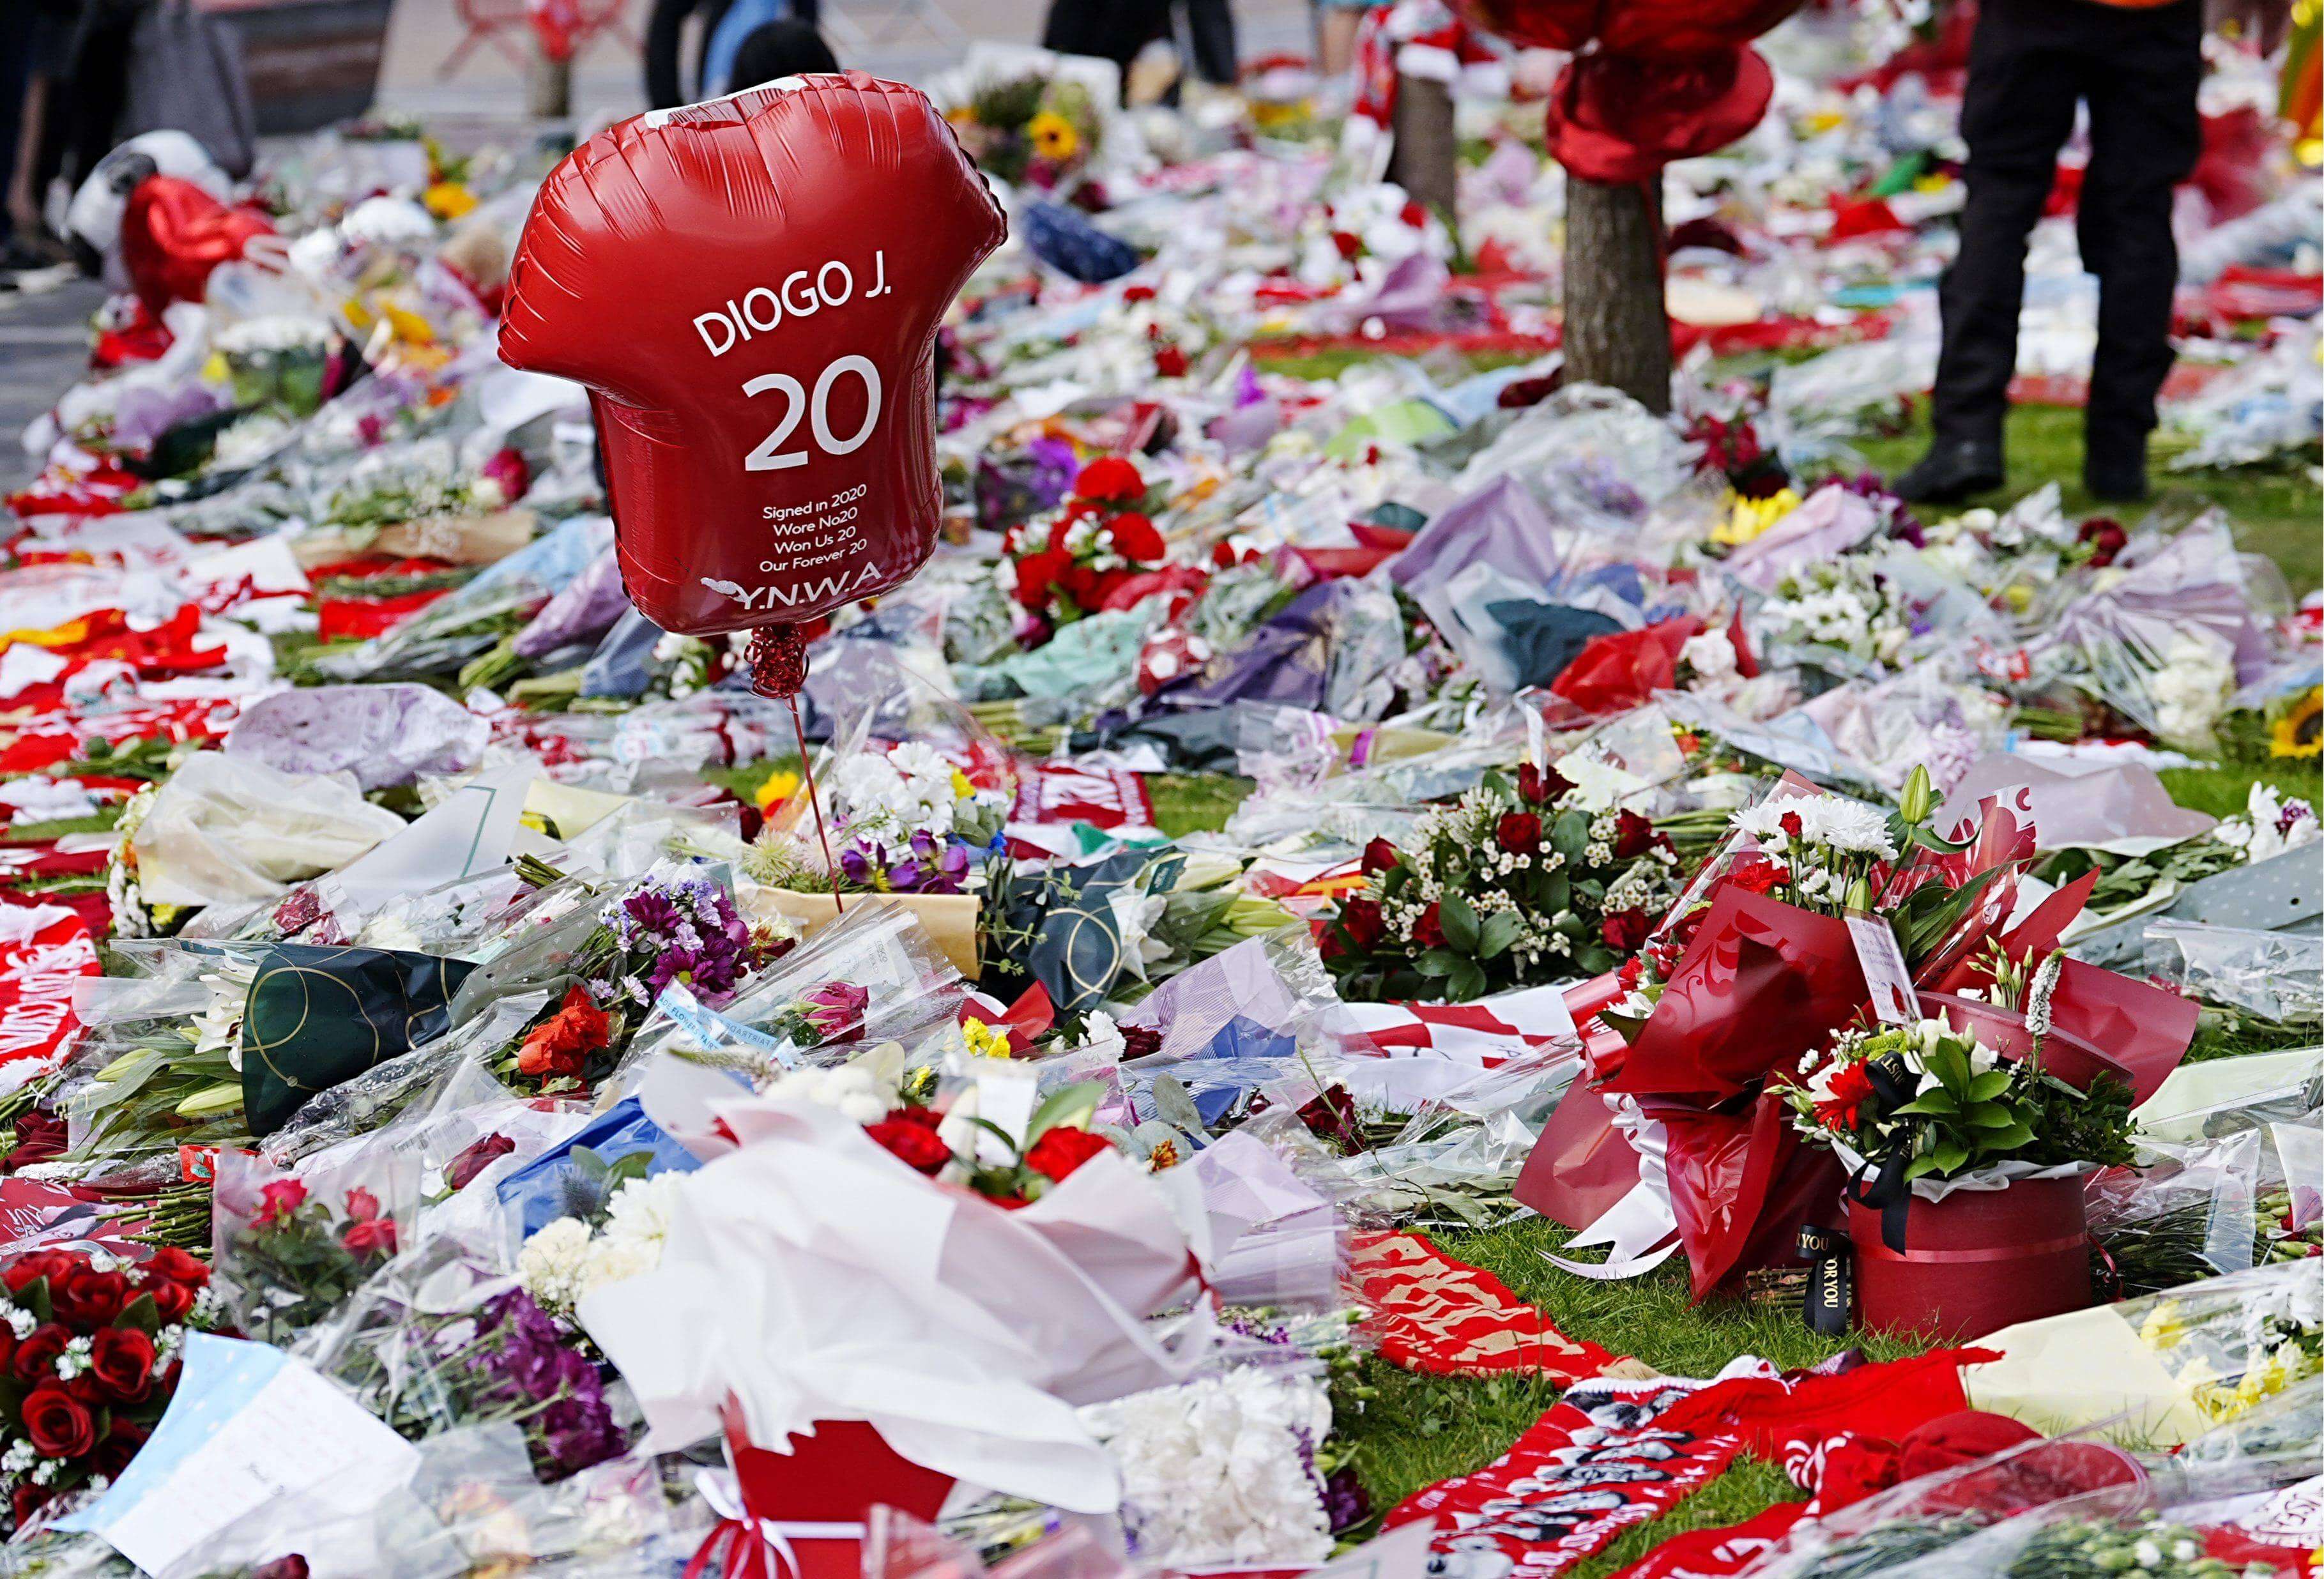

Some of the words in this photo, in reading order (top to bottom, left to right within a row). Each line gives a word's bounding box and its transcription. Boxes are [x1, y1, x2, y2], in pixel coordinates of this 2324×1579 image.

[693, 261, 853, 357] DIOGO
[865, 250, 891, 298] J.
[742, 355, 882, 471] 20
[762, 501, 813, 521] Signed
[815, 501, 828, 512] in
[831, 484, 867, 508] 2020
[773, 523, 816, 537] Wore
[819, 507, 858, 530] No20
[760, 560, 789, 572] Our
[792, 549, 846, 569] Forever
[849, 538, 868, 554] 20
[774, 541, 811, 554] Won
[815, 534, 834, 547] Us
[837, 526, 856, 542] 20
[733, 561, 882, 609] Y.N.W.A
[671, 1007, 699, 1035] FLOWERS
[1801, 1233, 1830, 1251] YOU
[1824, 1255, 1839, 1279] OR
[1823, 1279, 1839, 1308] YOU
